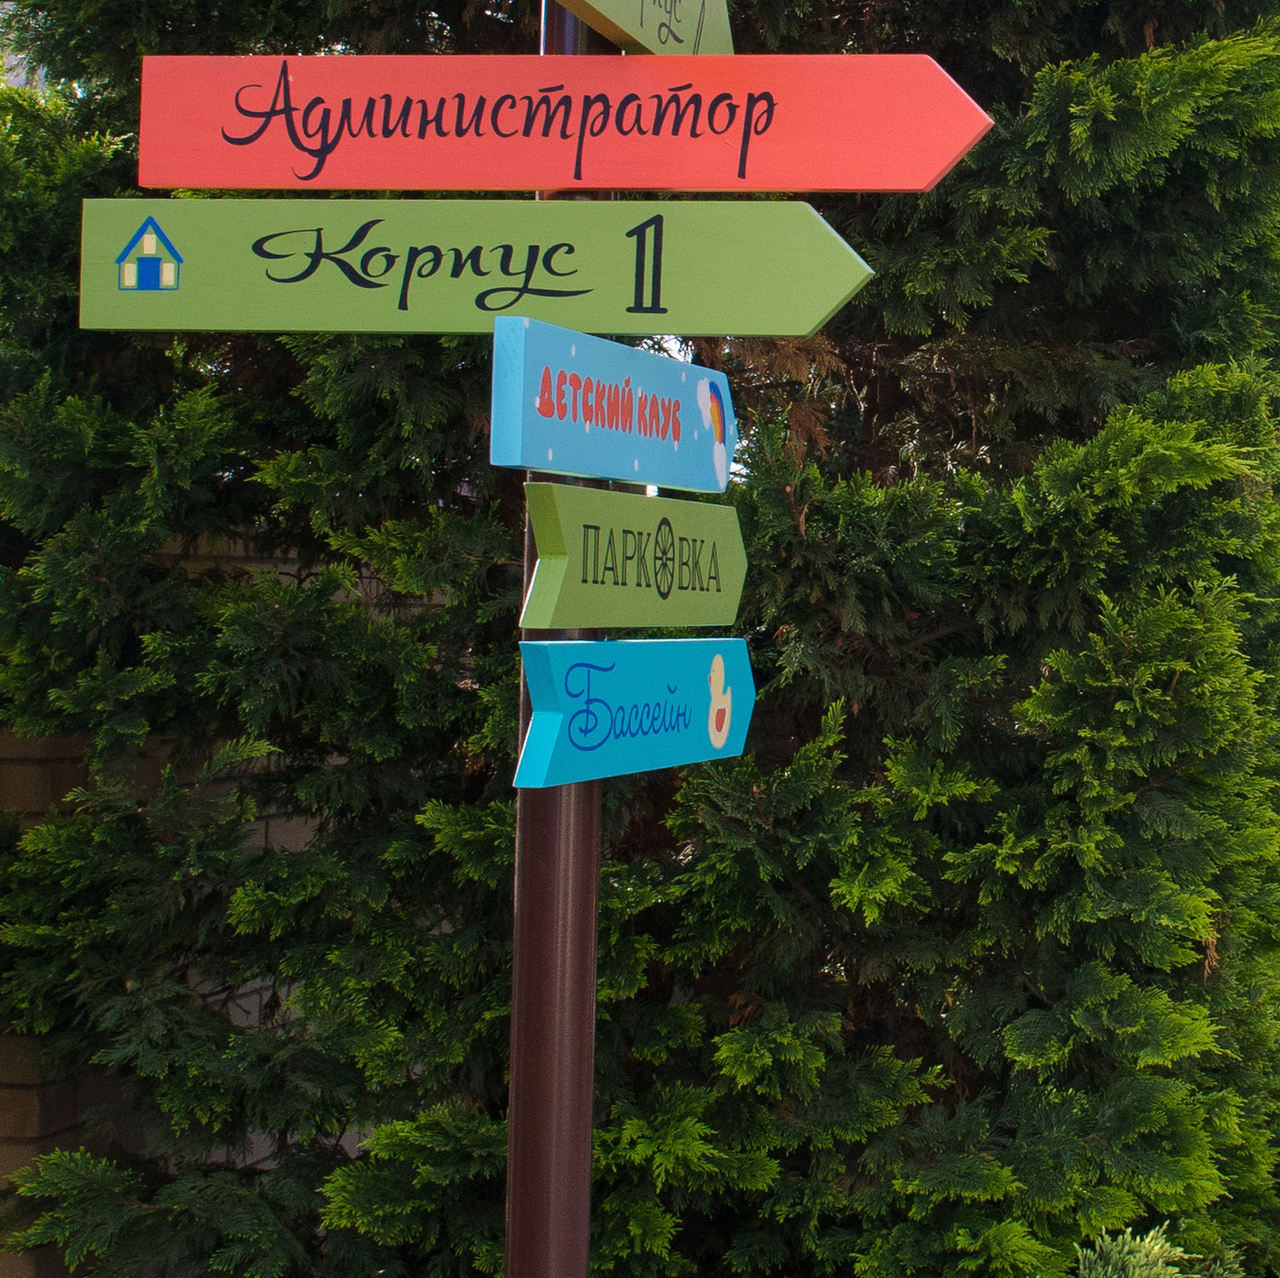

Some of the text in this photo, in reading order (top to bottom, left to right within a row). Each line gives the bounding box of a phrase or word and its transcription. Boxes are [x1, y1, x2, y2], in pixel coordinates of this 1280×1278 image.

[221, 60, 779, 181] Администратор
[251, 214, 668, 315] Корпус 1
[536, 365, 682, 443] ДЕТСКИЙ КЛУБ
[582, 517, 721, 600] ПАРКОВКА
[564, 662, 693, 752] Бассейн
